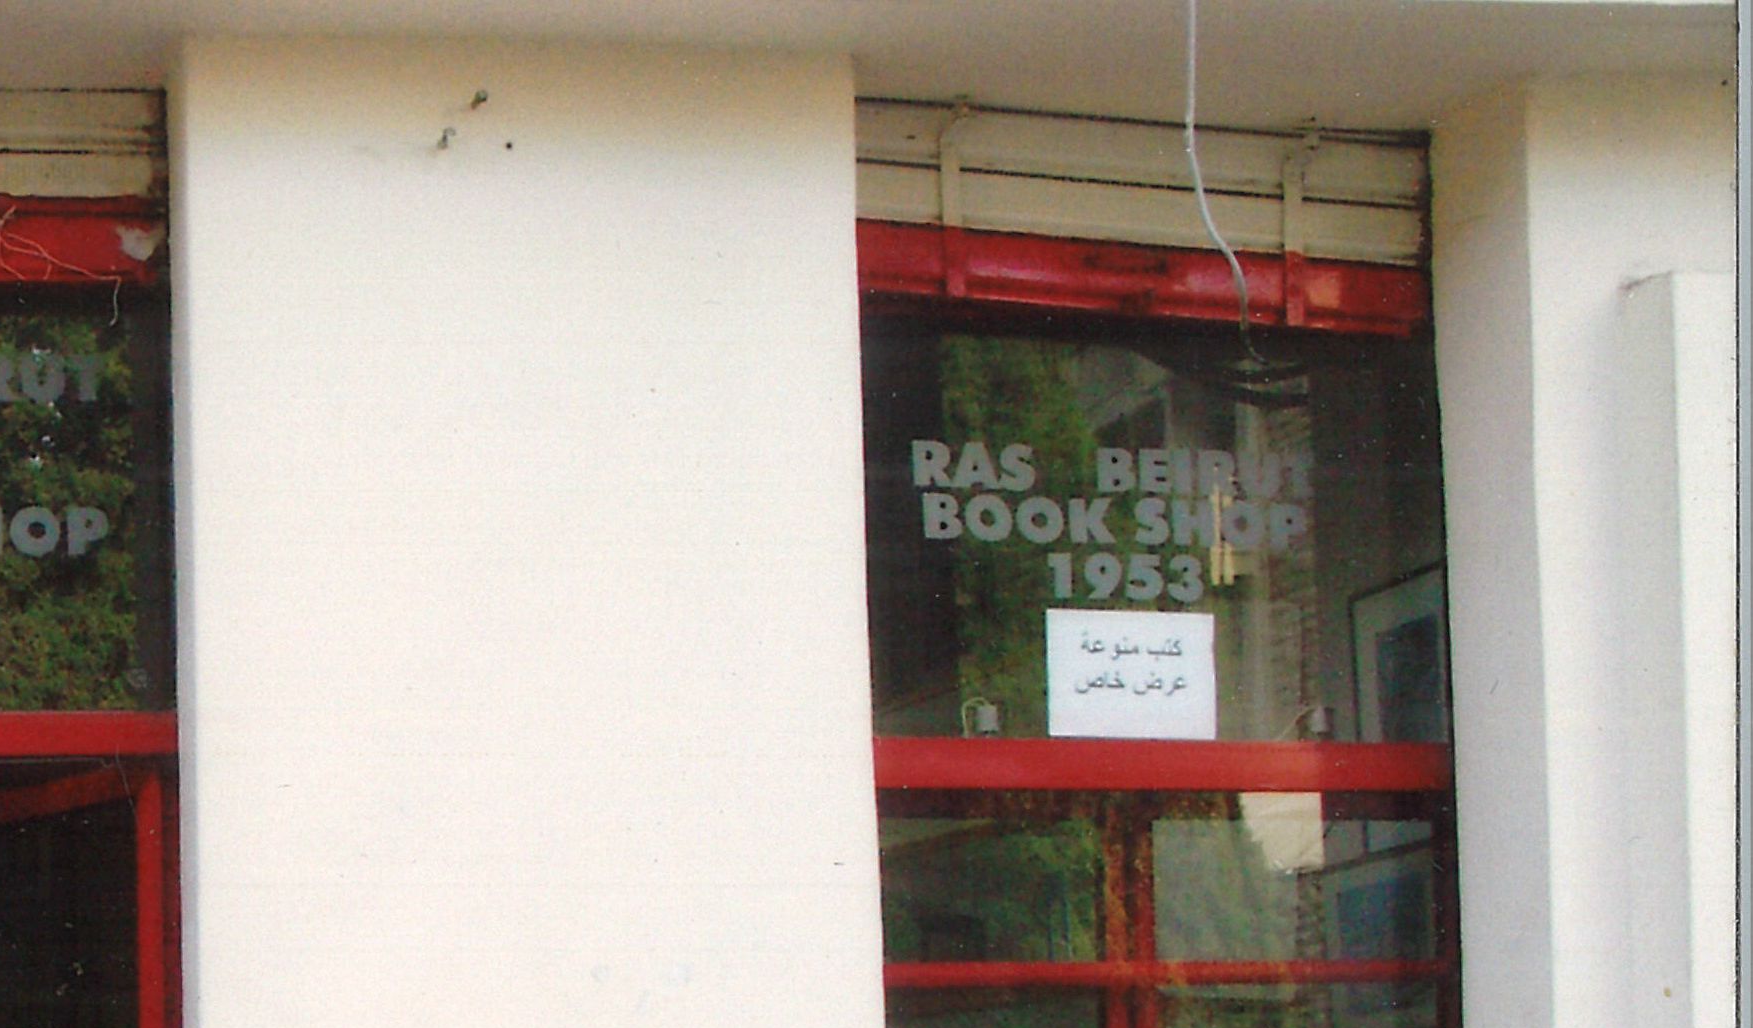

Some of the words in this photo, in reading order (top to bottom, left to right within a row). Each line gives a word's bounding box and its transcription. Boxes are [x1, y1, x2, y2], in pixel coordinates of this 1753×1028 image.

[911, 439, 1036, 492] RAS
[1096, 447, 1314, 500] BEIRUT
[921, 492, 1116, 545] BOOK
[1134, 496, 1308, 551] SHOP
[1047, 551, 1206, 602] 1953
[1080, 630, 1140, 661] منوعة
[1145, 638, 1183, 662] كتب
[1074, 670, 1126, 695] خاص
[1133, 671, 1188, 697] عرض
